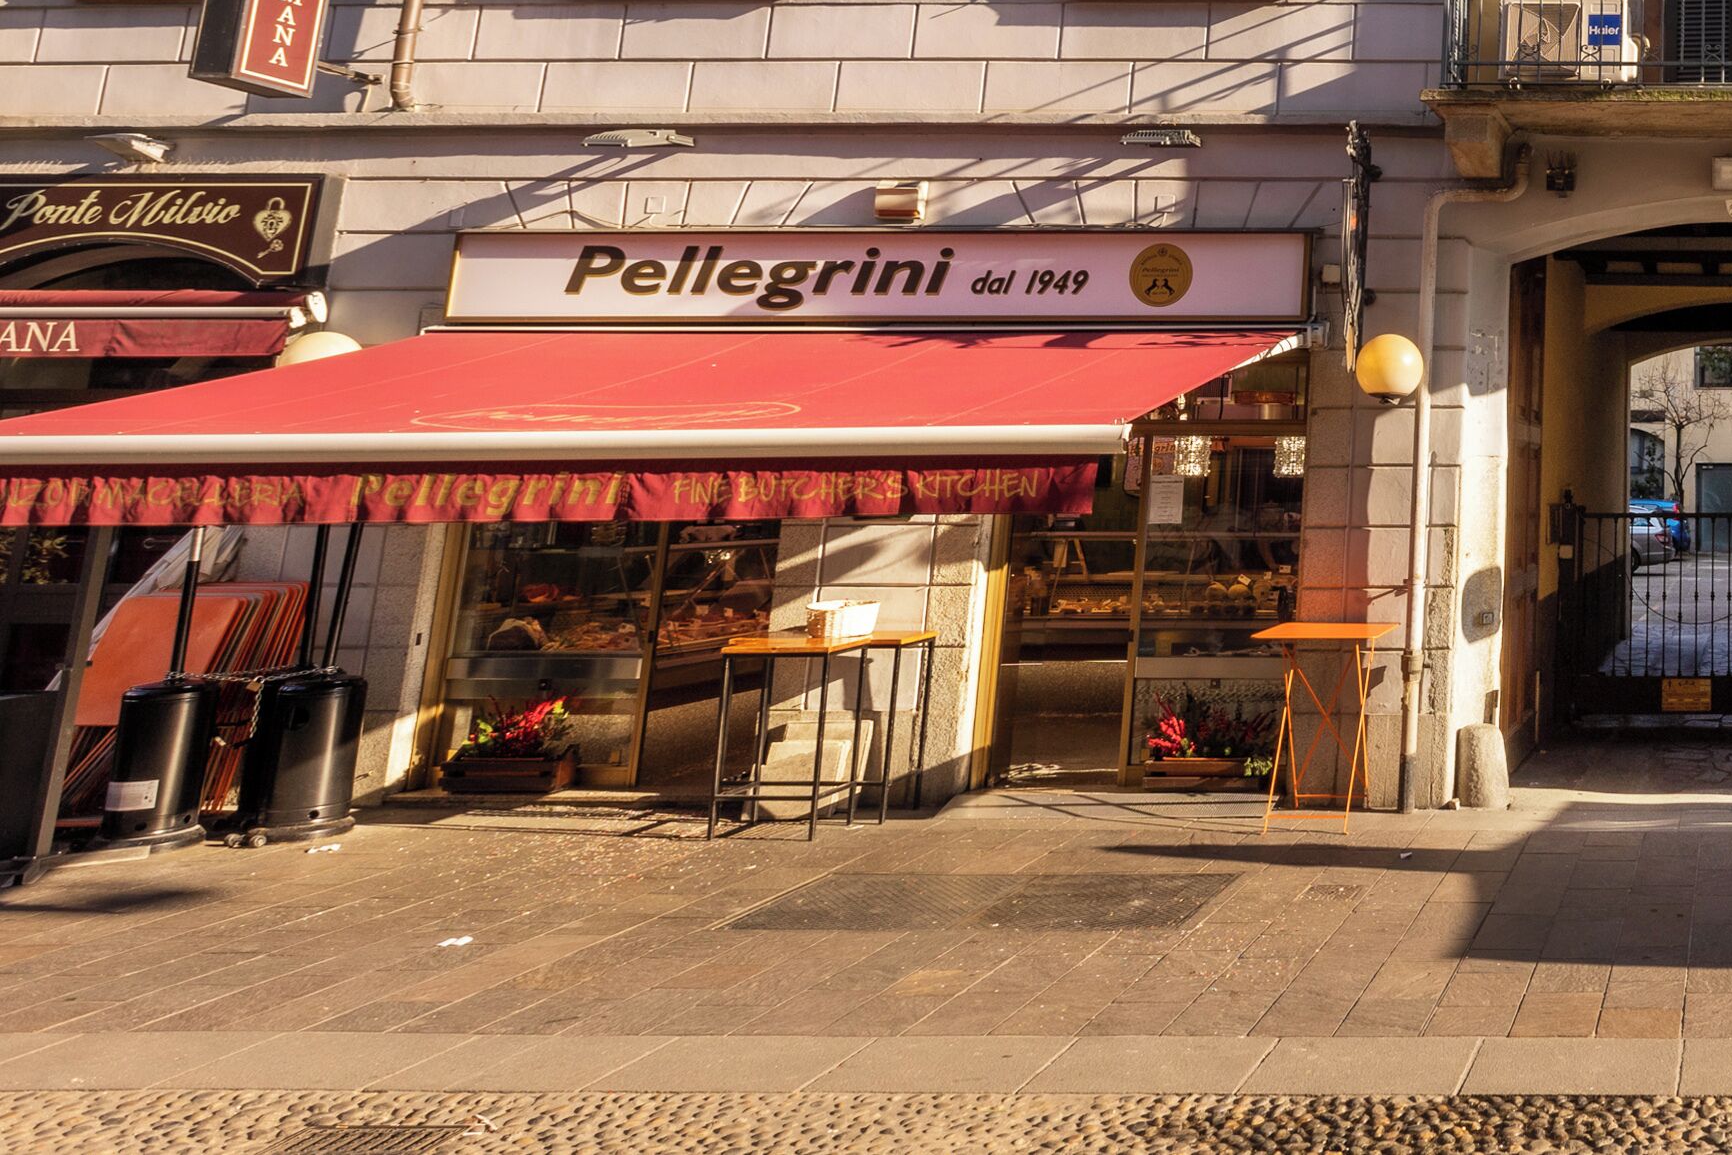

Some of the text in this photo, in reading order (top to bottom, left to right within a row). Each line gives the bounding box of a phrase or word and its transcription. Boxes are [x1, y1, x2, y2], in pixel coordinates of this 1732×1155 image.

[1588, 24, 1620, 35] Haier
[0, 189, 241, 232] Ponte Milvio
[563, 244, 1089, 312] Pellegrini dal 1949
[350, 470, 626, 517] Pellegrini
[673, 476, 733, 505] FINE
[738, 471, 909, 505] BUTCHER'S
[916, 468, 1039, 501] KITCHEN
